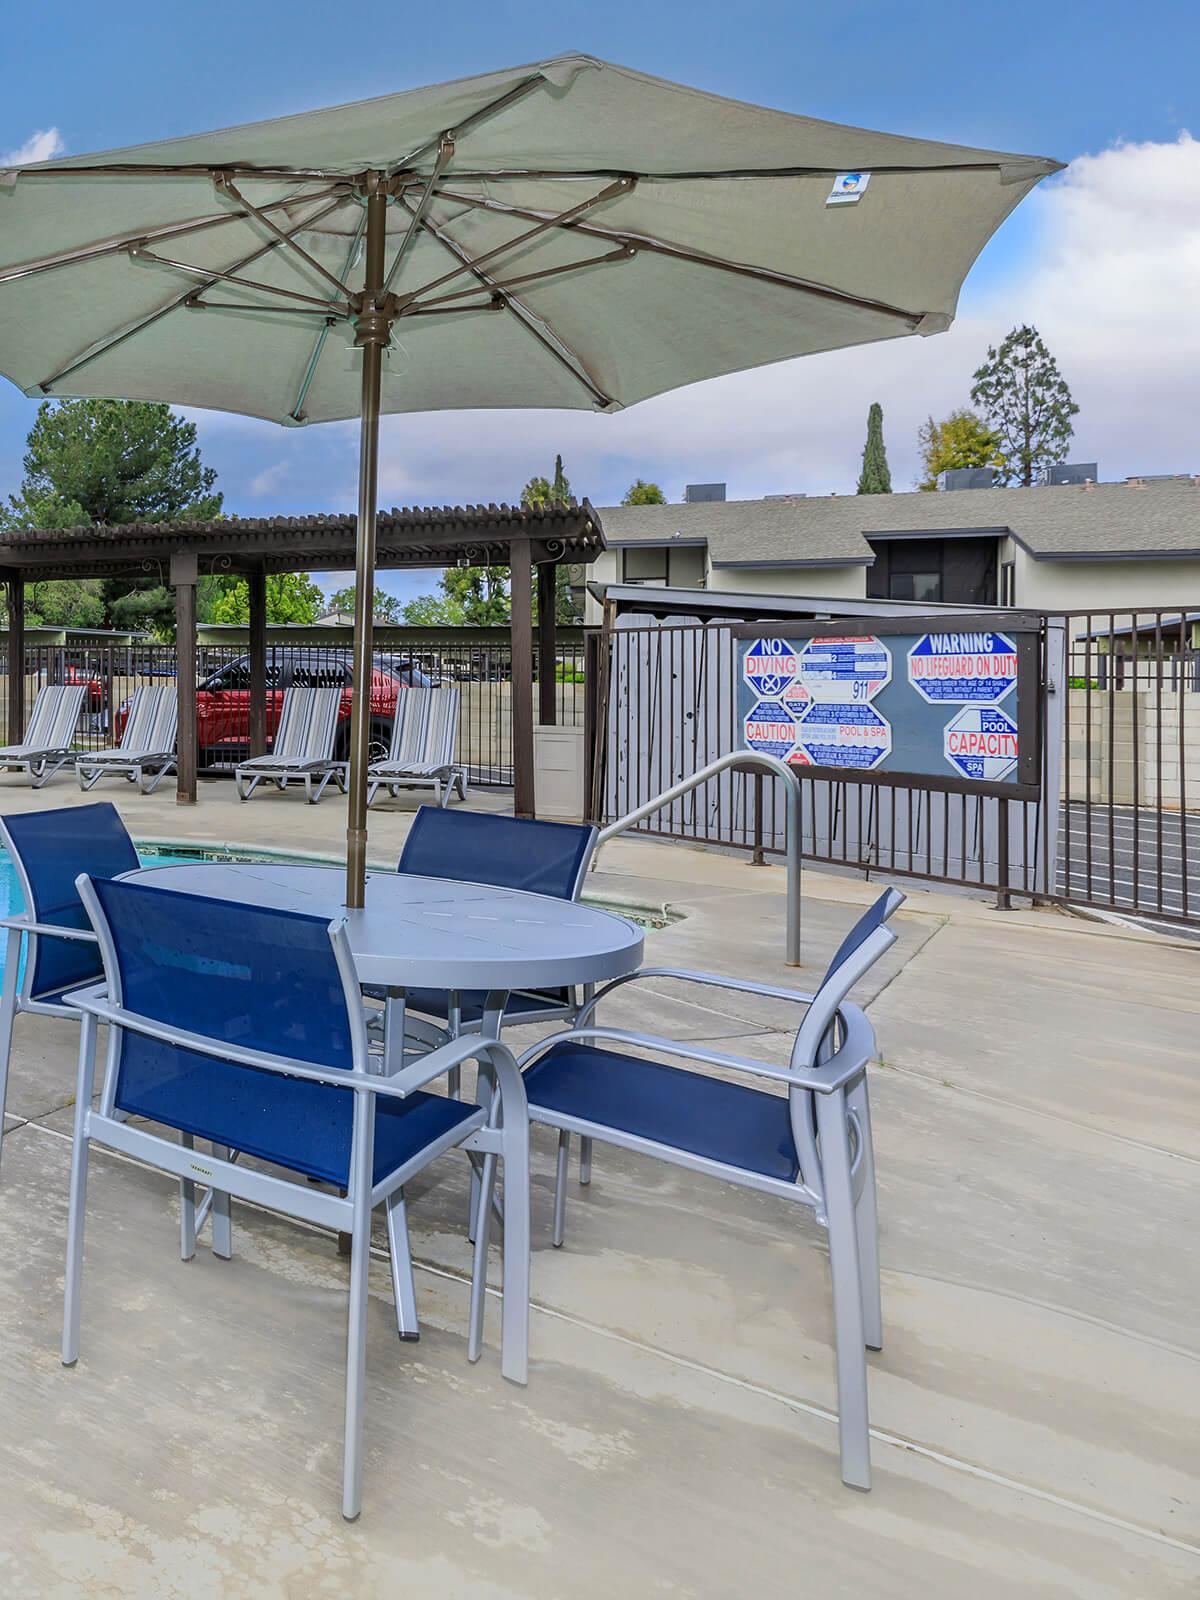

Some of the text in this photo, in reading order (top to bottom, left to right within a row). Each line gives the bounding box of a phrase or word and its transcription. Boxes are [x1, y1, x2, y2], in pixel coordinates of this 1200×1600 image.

[761, 639, 782, 655] NO
[929, 633, 993, 653] WARNING
[746, 656, 796, 674] DIVING
[911, 655, 1018, 676] NO LIFEGUARD ON DUTY
[853, 681, 868, 699] 911
[746, 723, 796, 741] CAUTION
[839, 726, 862, 736] POOL
[863, 727, 869, 736] &
[871, 727, 886, 736] SPA
[982, 722, 1011, 732] POOL
[949, 733, 1018, 756] CAPACITY
[967, 763, 983, 772] SPA
